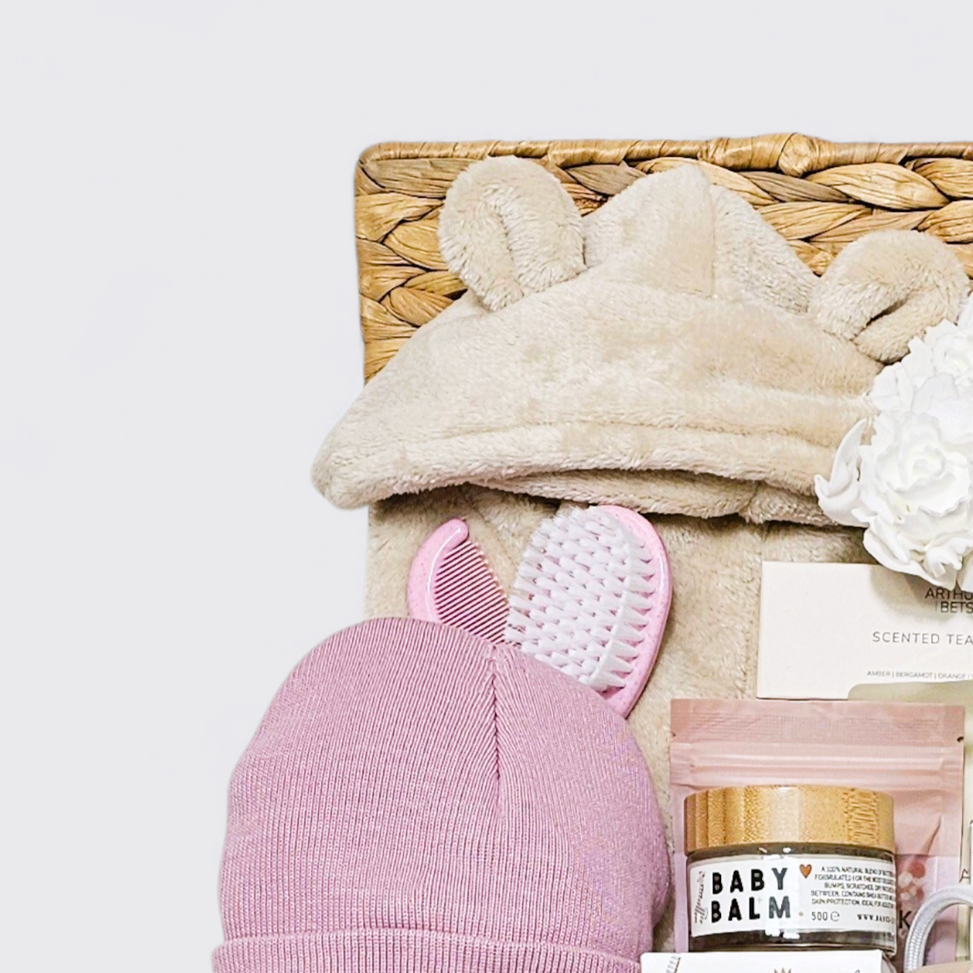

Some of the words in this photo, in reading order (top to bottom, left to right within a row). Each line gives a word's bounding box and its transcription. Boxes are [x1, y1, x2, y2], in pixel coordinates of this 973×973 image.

[872, 631, 940, 644] SCENTED
[946, 633, 973, 646] TEA
[712, 867, 788, 895] BABY
[711, 896, 791, 923] BALM
